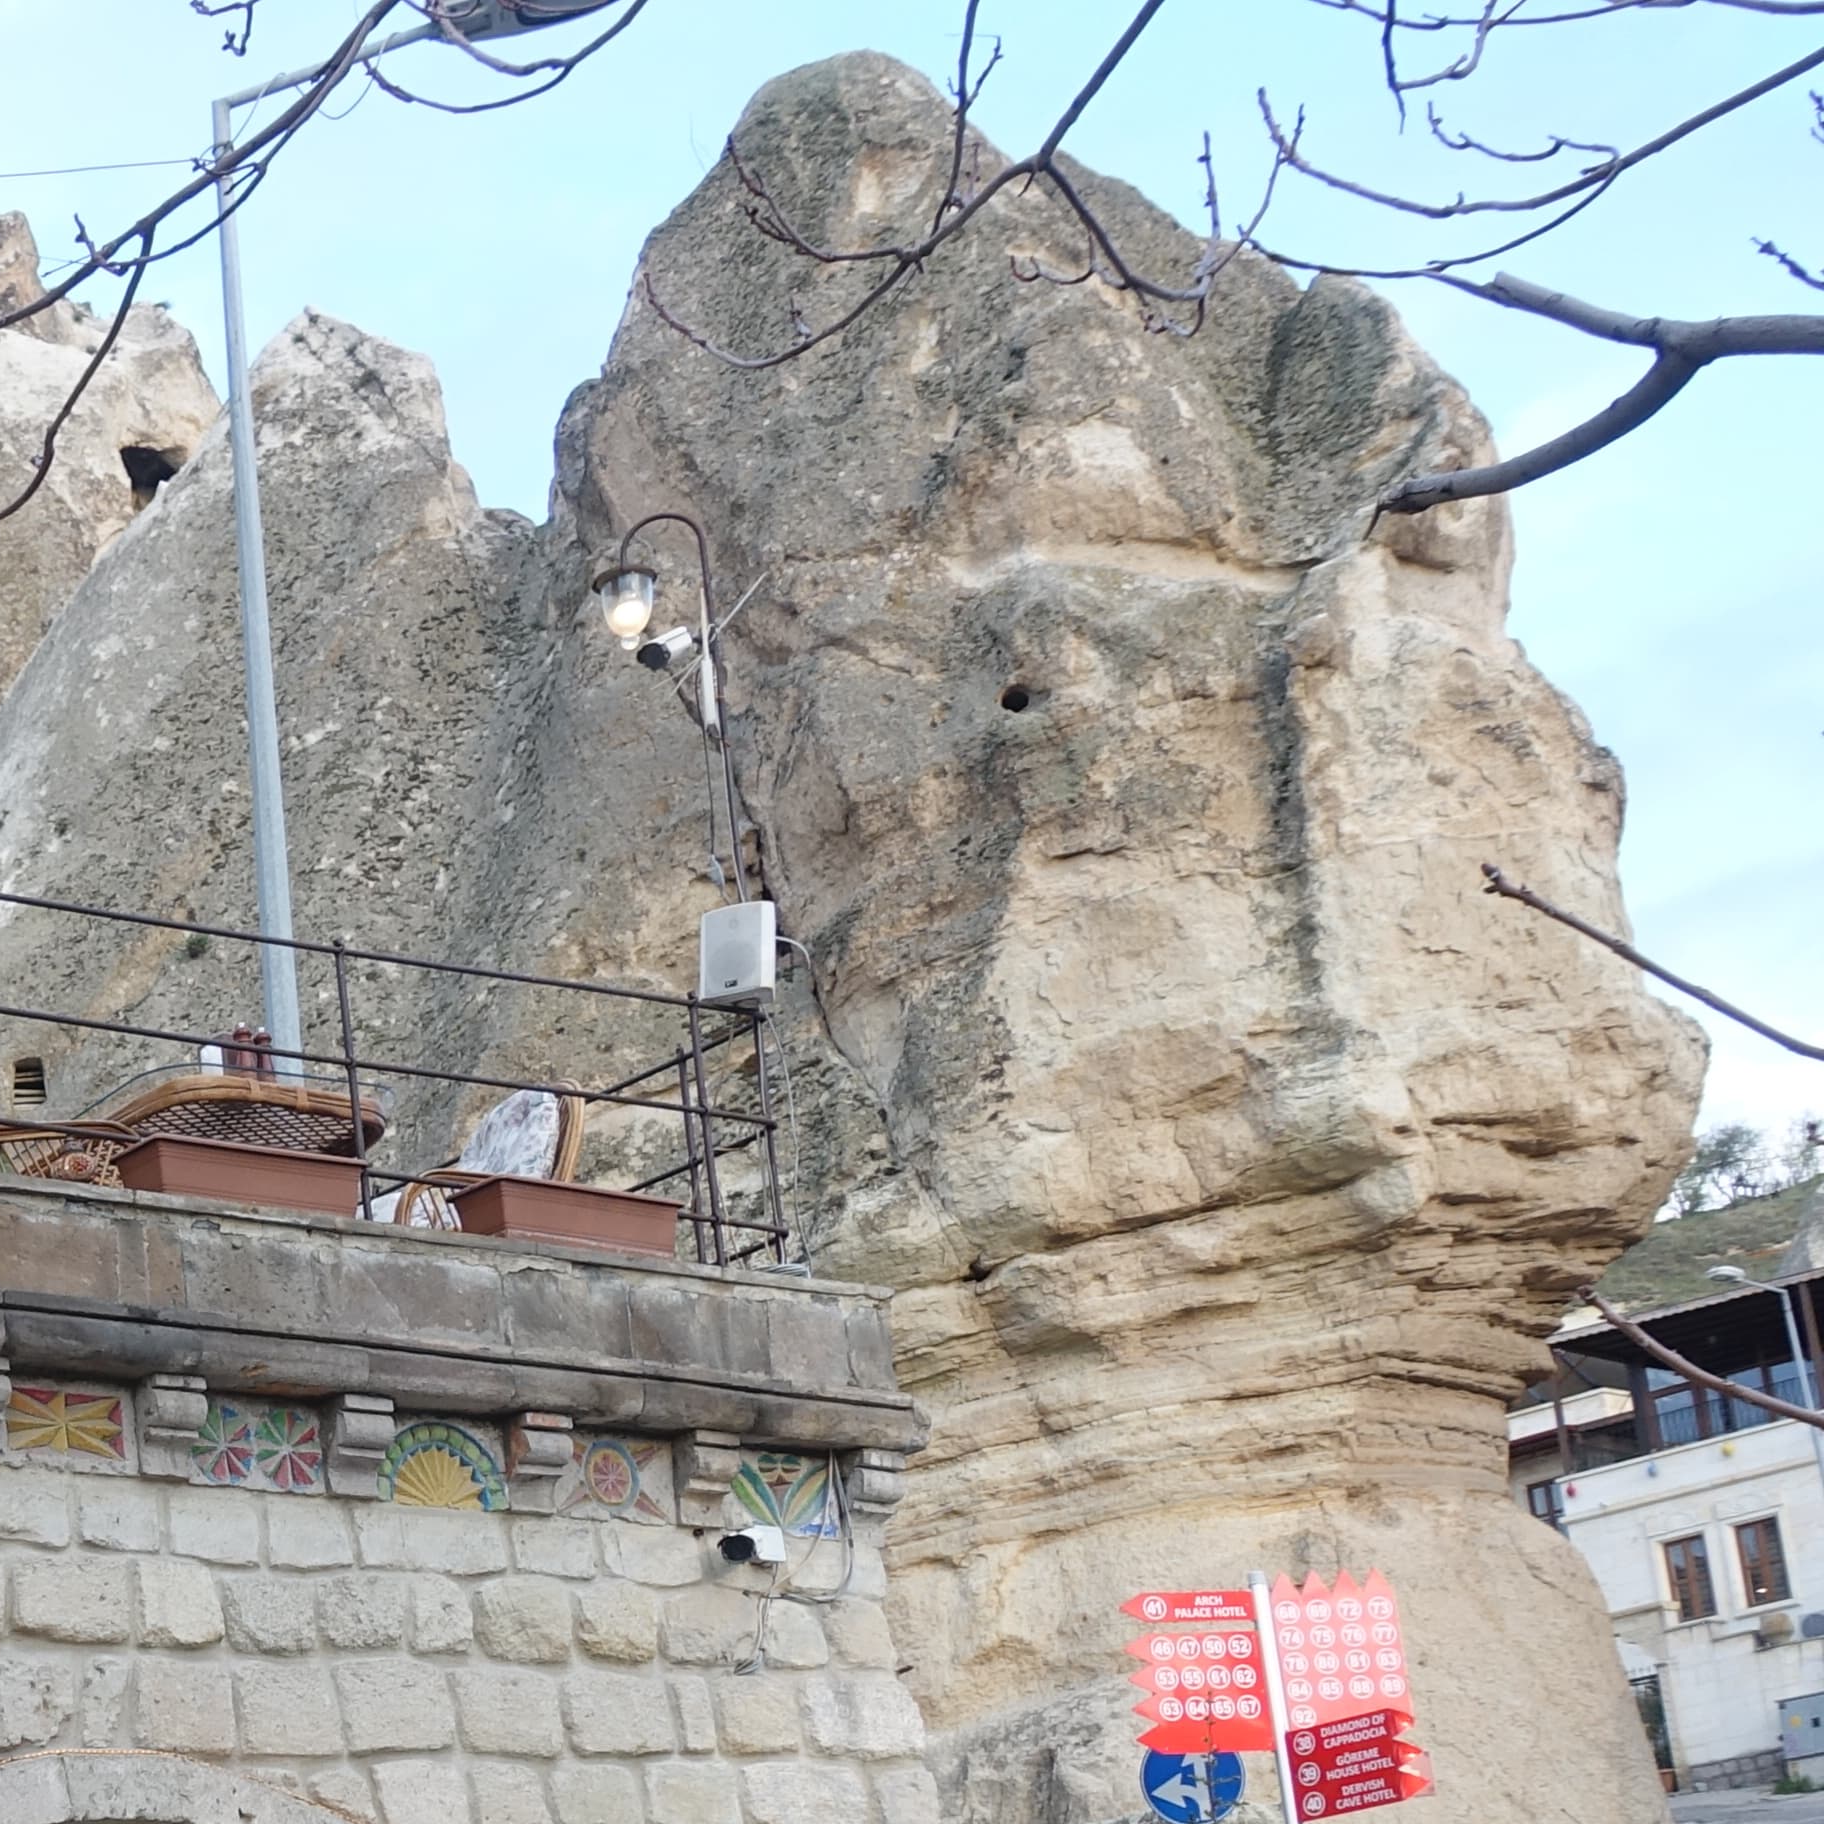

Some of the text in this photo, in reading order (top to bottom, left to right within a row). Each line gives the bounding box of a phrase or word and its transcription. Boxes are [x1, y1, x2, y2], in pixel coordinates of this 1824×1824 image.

[1194, 1595, 1223, 1606] ARCH
[1174, 1606, 1247, 1618] PALACE HOTEL
[1320, 1713, 1386, 1738] DIAMOND OF
[1323, 1726, 1388, 1749] CAPPADOCIA
[1335, 1747, 1380, 1766] GÖREME
[1326, 1757, 1395, 1780] HOUSE HOTEL
[1341, 1778, 1385, 1796] DERVISH
[1335, 1788, 1397, 1810] CAVE HOTEL
